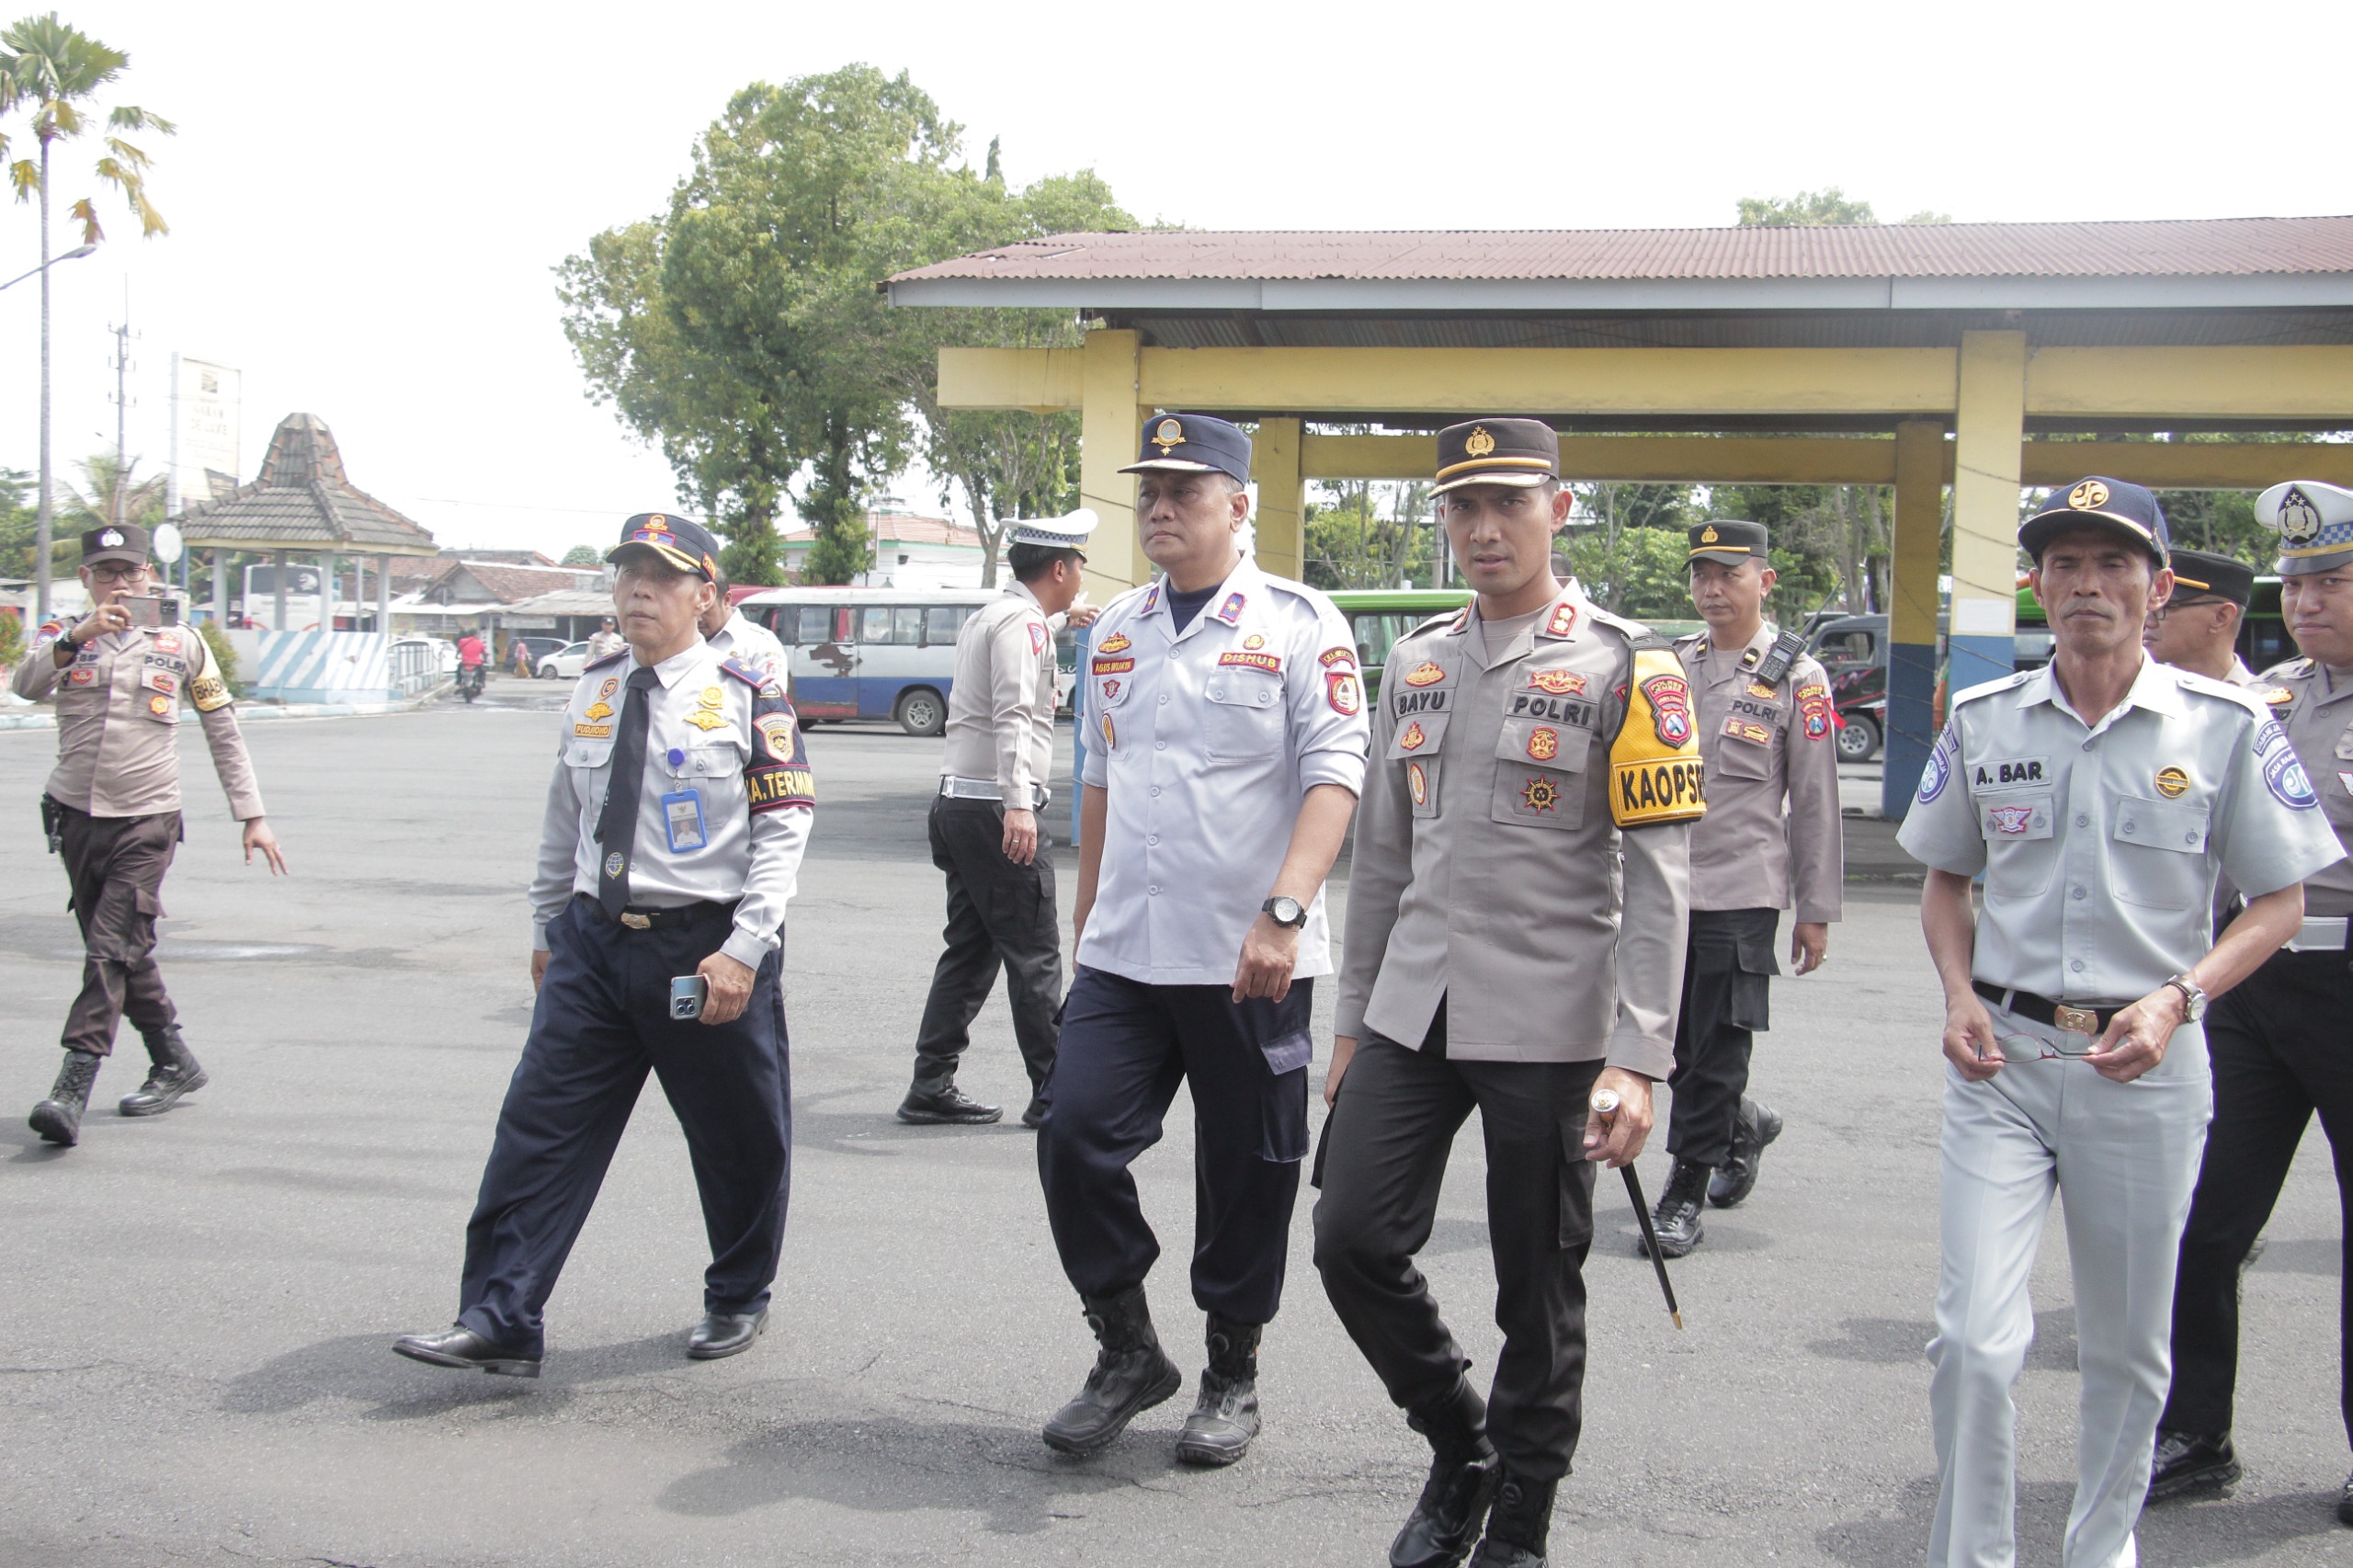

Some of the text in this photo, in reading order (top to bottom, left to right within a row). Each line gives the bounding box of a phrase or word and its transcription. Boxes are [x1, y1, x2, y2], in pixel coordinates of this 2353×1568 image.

[144, 655, 187, 673] POLRI
[1095, 663, 1111, 674] AGUS
[1222, 653, 1277, 668] DISHUB
[1398, 690, 1447, 715] BAYU
[1513, 697, 1593, 726] POLRI
[1732, 699, 1778, 722] POLRI
[576, 725, 609, 736] PUDJIONO
[1975, 761, 2042, 786] A. BAR
[2269, 762, 2283, 779] JASA
